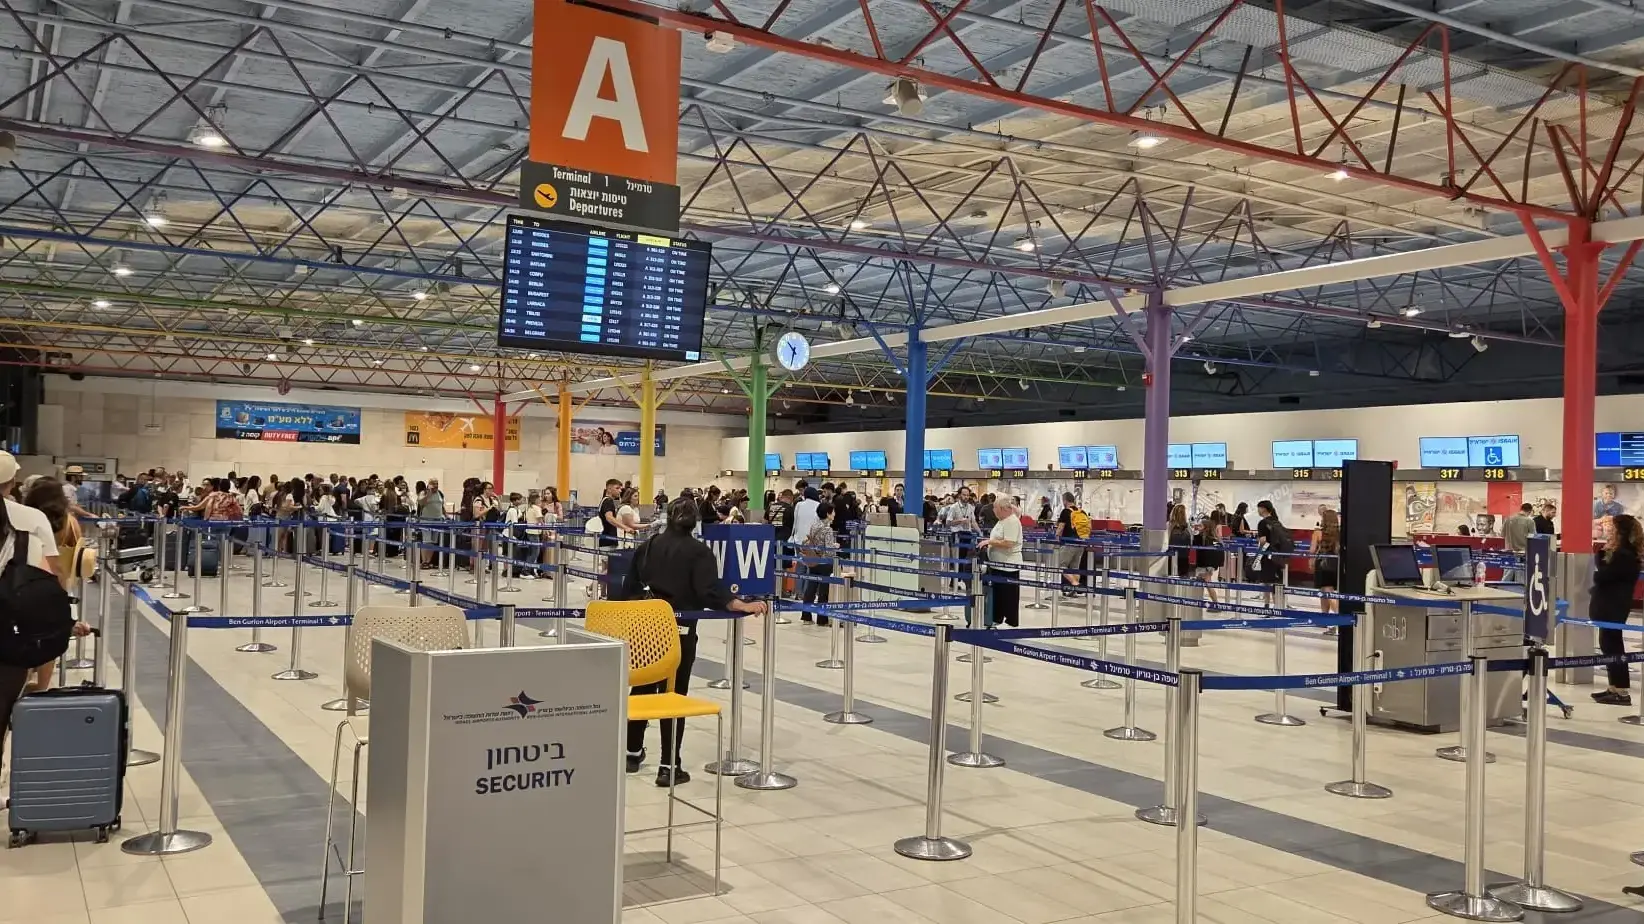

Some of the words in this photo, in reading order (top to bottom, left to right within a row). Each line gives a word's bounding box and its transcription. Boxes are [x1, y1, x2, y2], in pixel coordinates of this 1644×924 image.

[561, 35, 649, 153] A
[552, 167, 591, 185] Terminal
[604, 175, 609, 187] 1
[626, 180, 652, 194] טרמינל
[570, 187, 600, 201] יוצאות
[601, 192, 627, 205] טיסות
[569, 198, 623, 217] Departures
[1294, 470, 1308, 478] 315
[1332, 470, 1342, 478] 31
[1440, 469, 1460, 478] 317
[1484, 469, 1504, 478] 318
[735, 540, 770, 579] W
[265, 618, 287, 626] Airport
[1013, 645, 1021, 653] Ben
[1022, 647, 1038, 657] Gurion
[1039, 650, 1056, 661] Airport
[1059, 654, 1081, 666] Terminal
[1110, 664, 1131, 675] טרמינל
[1135, 669, 1160, 680] בן-גוריון
[1414, 668, 1435, 678] טרמינל
[1304, 677, 1316, 685] Ben
[1318, 676, 1338, 684] Gurion
[1338, 674, 1360, 684] Airport
[1363, 672, 1388, 681] Terminal
[486, 742, 566, 771] ביטחון
[475, 768, 576, 795] SECURITY
